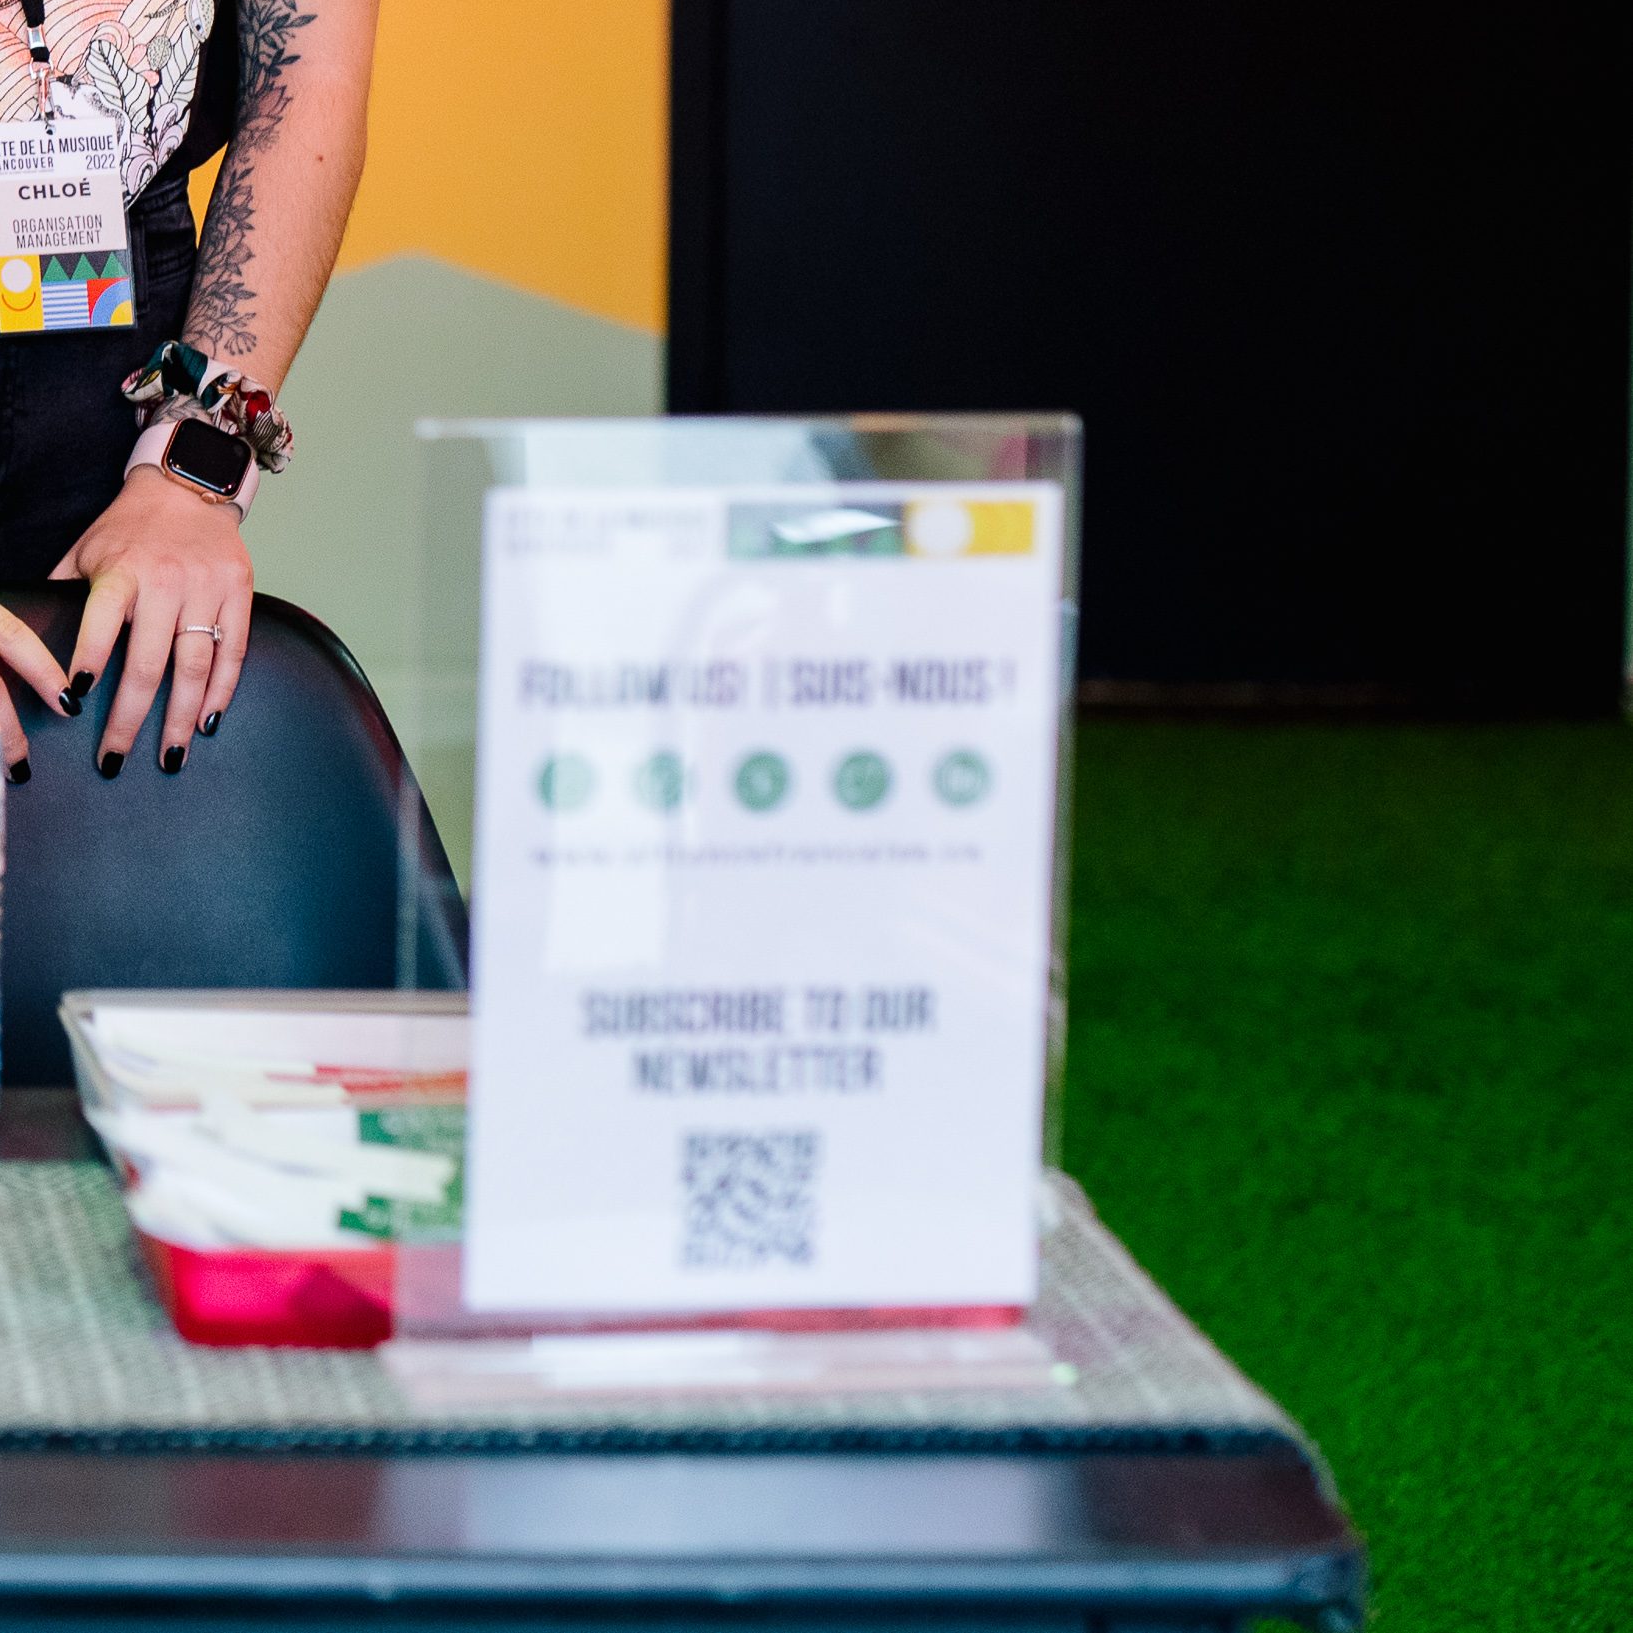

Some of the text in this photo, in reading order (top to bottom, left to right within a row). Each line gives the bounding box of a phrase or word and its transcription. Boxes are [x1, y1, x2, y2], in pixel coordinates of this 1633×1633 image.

[20, 140, 36, 156] DE
[39, 138, 55, 154] LA
[59, 135, 114, 153] MUSIQUE
[85, 154, 116, 170] 2022
[18, 178, 92, 200] CHLOÉ
[12, 214, 102, 233] ORGANISATION
[16, 229, 102, 249] MANAGEMENT
[518, 660, 671, 710] FOLLOW
[579, 983, 938, 1038] SUBSCRIBE TO OUR
[631, 1045, 884, 1096] NEWSLETTER
